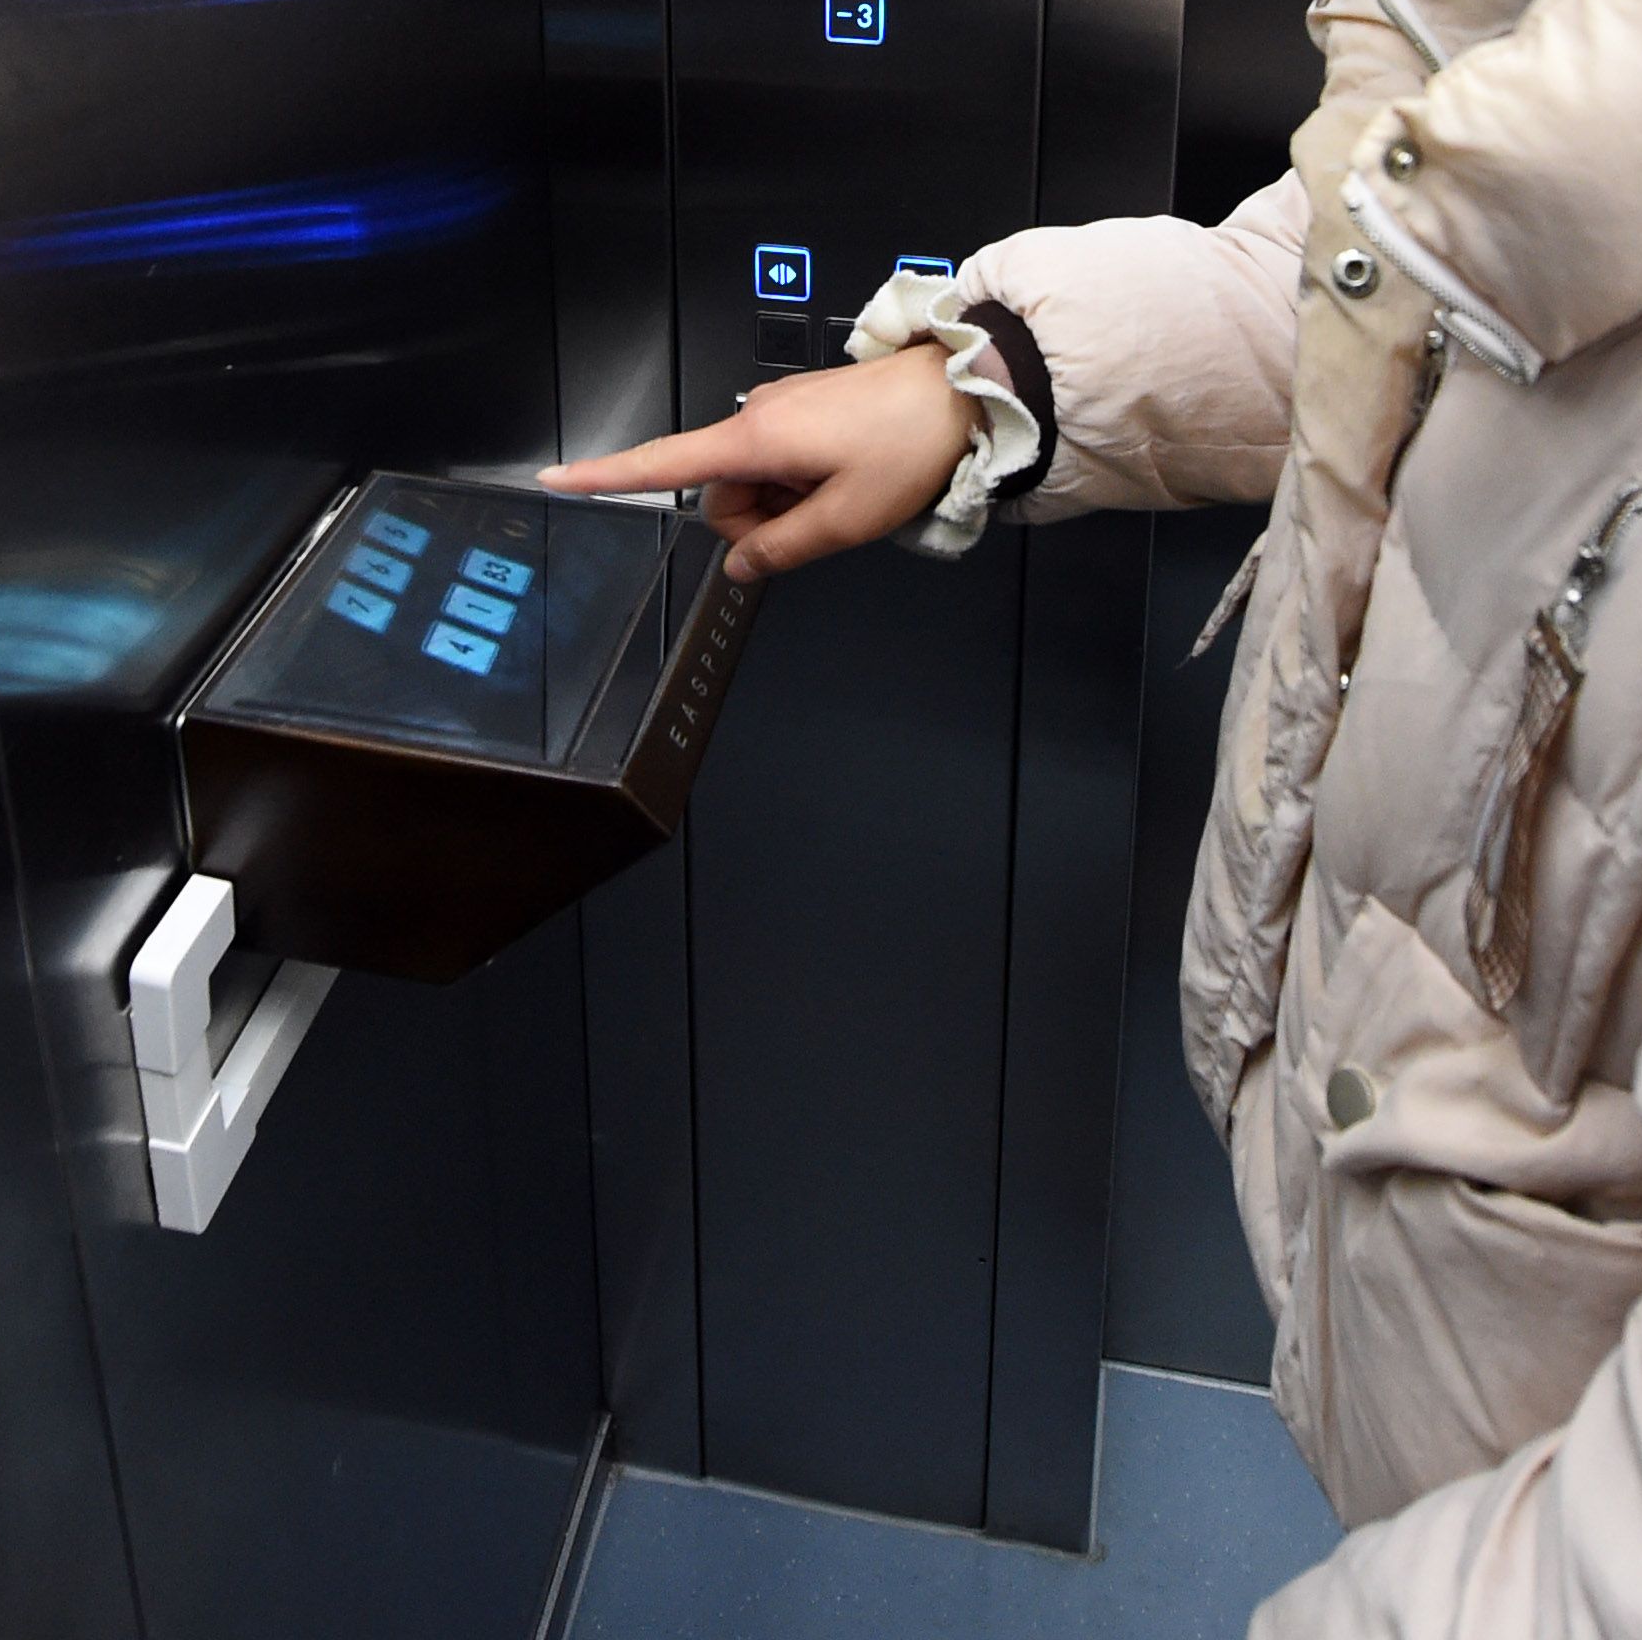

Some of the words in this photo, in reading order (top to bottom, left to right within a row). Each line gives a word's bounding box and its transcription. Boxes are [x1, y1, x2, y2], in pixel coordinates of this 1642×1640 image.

[836, 3, 873, 28] -3
[367, 559, 391, 576] 6
[481, 561, 512, 584] B3
[347, 596, 370, 614] 7
[466, 602, 493, 615] 1
[448, 639, 475, 655] 4
[668, 586, 745, 750] EASPEED
